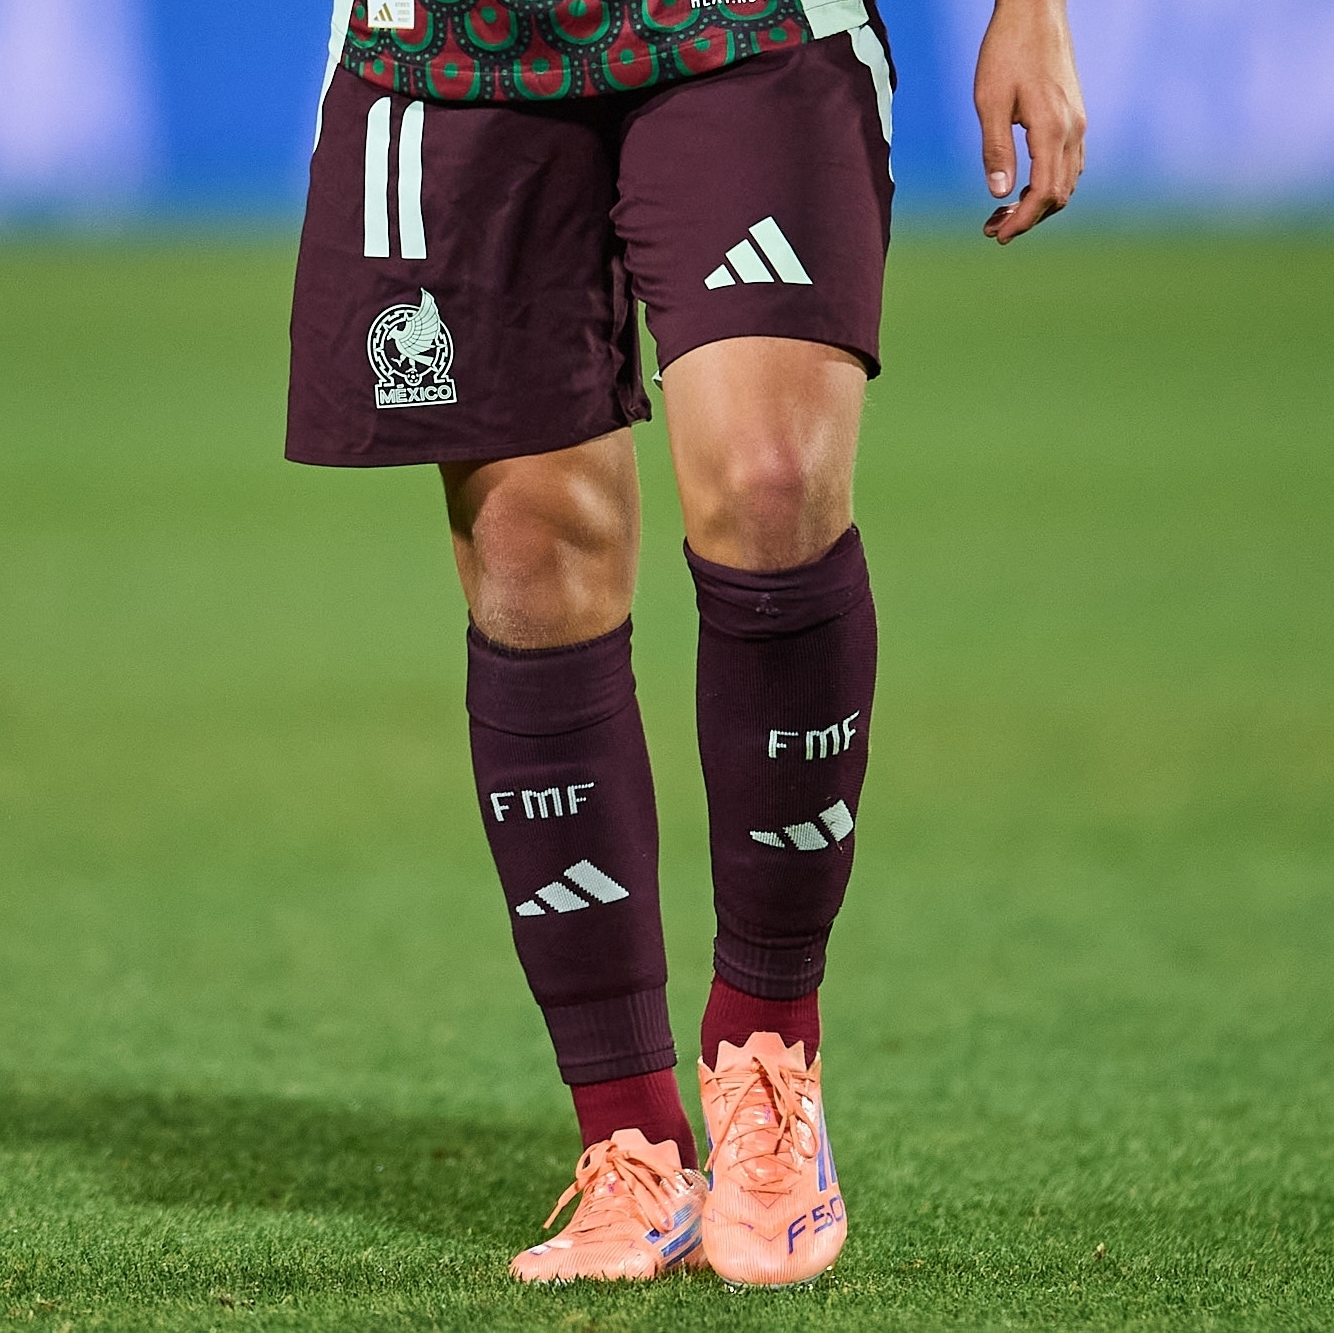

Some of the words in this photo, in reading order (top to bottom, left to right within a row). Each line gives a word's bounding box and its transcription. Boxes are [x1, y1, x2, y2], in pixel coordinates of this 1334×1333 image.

[363, 96, 427, 259] 11
[768, 710, 860, 761] FMF
[490, 782, 595, 822] FMF
